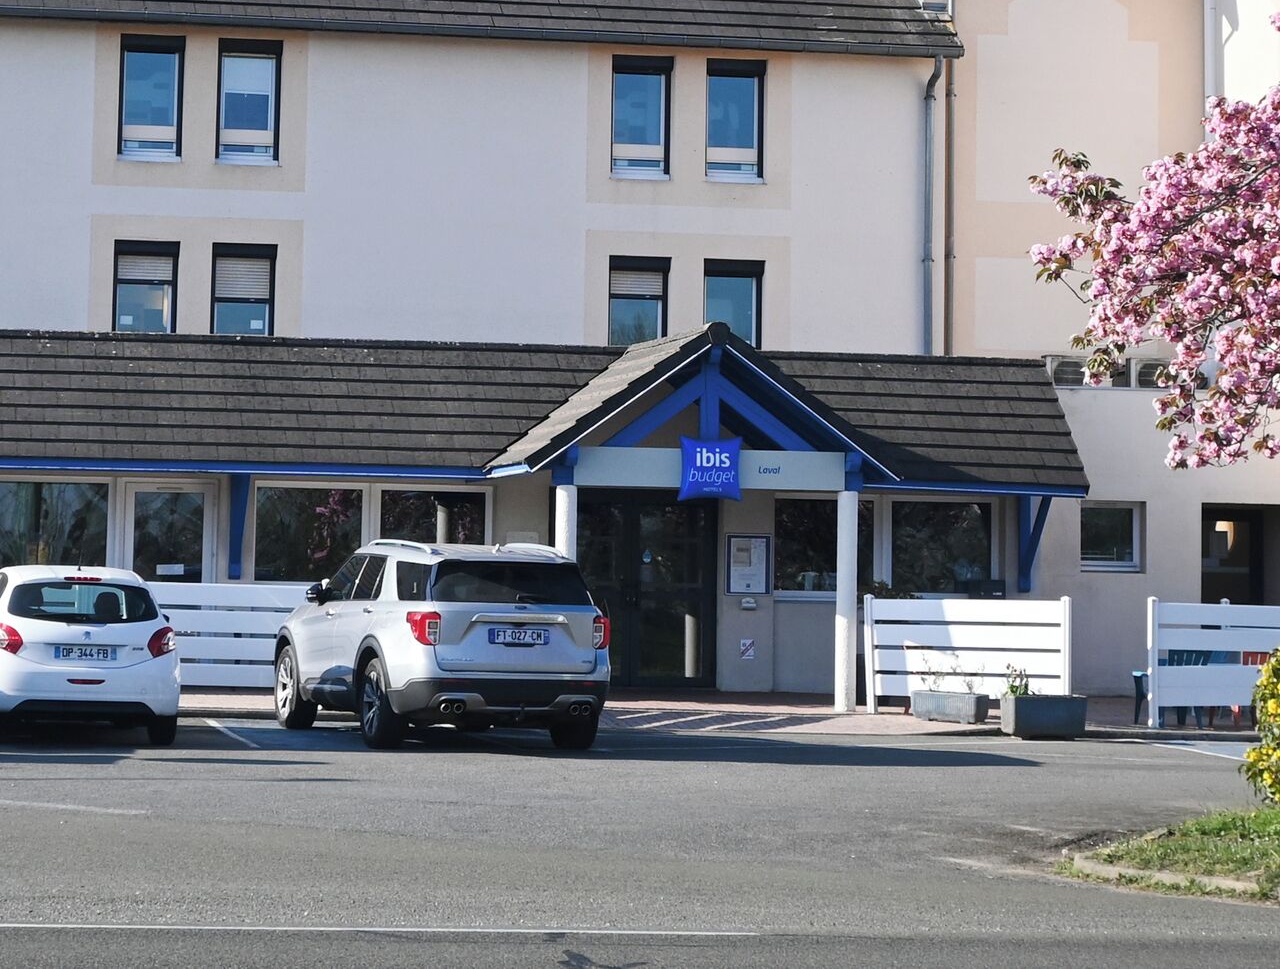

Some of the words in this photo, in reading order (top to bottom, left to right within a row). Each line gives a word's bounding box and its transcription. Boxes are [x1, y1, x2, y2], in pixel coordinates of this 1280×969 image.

[696, 448, 731, 467] ibis
[689, 468, 735, 486] budget
[758, 466, 781, 475] Laval
